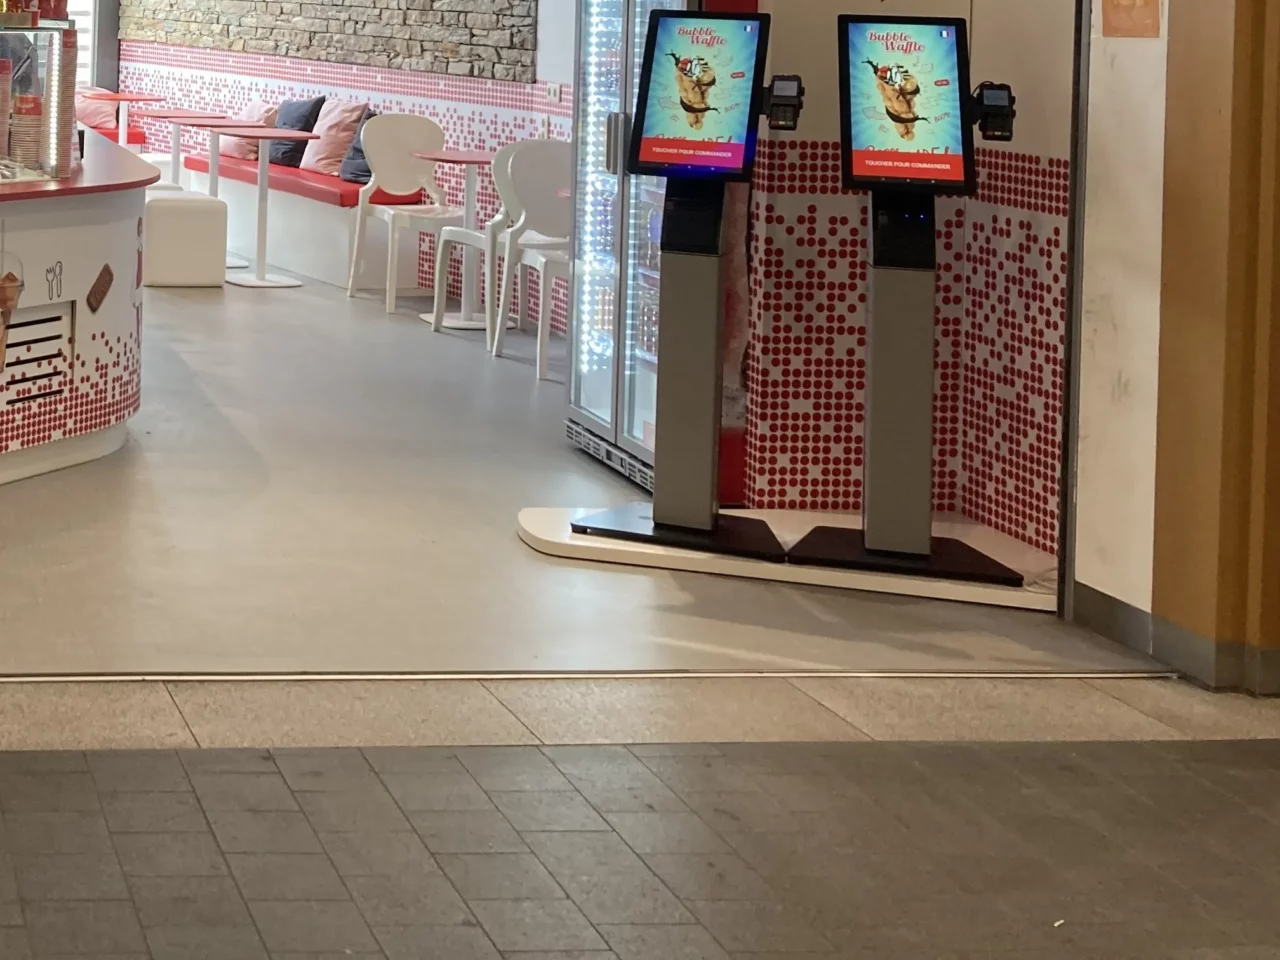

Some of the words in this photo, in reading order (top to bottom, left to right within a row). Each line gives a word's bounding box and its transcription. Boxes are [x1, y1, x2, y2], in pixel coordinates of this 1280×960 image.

[677, 25, 716, 36] Bubble
[689, 35, 727, 48] Waffle
[868, 31, 911, 42] Bubble
[882, 41, 925, 55] Waffle
[652, 147, 679, 155] TOUCHER
[695, 149, 732, 158] COMMANDER
[865, 159, 893, 168] TOUCHER
[911, 161, 951, 170] COMMANDER
